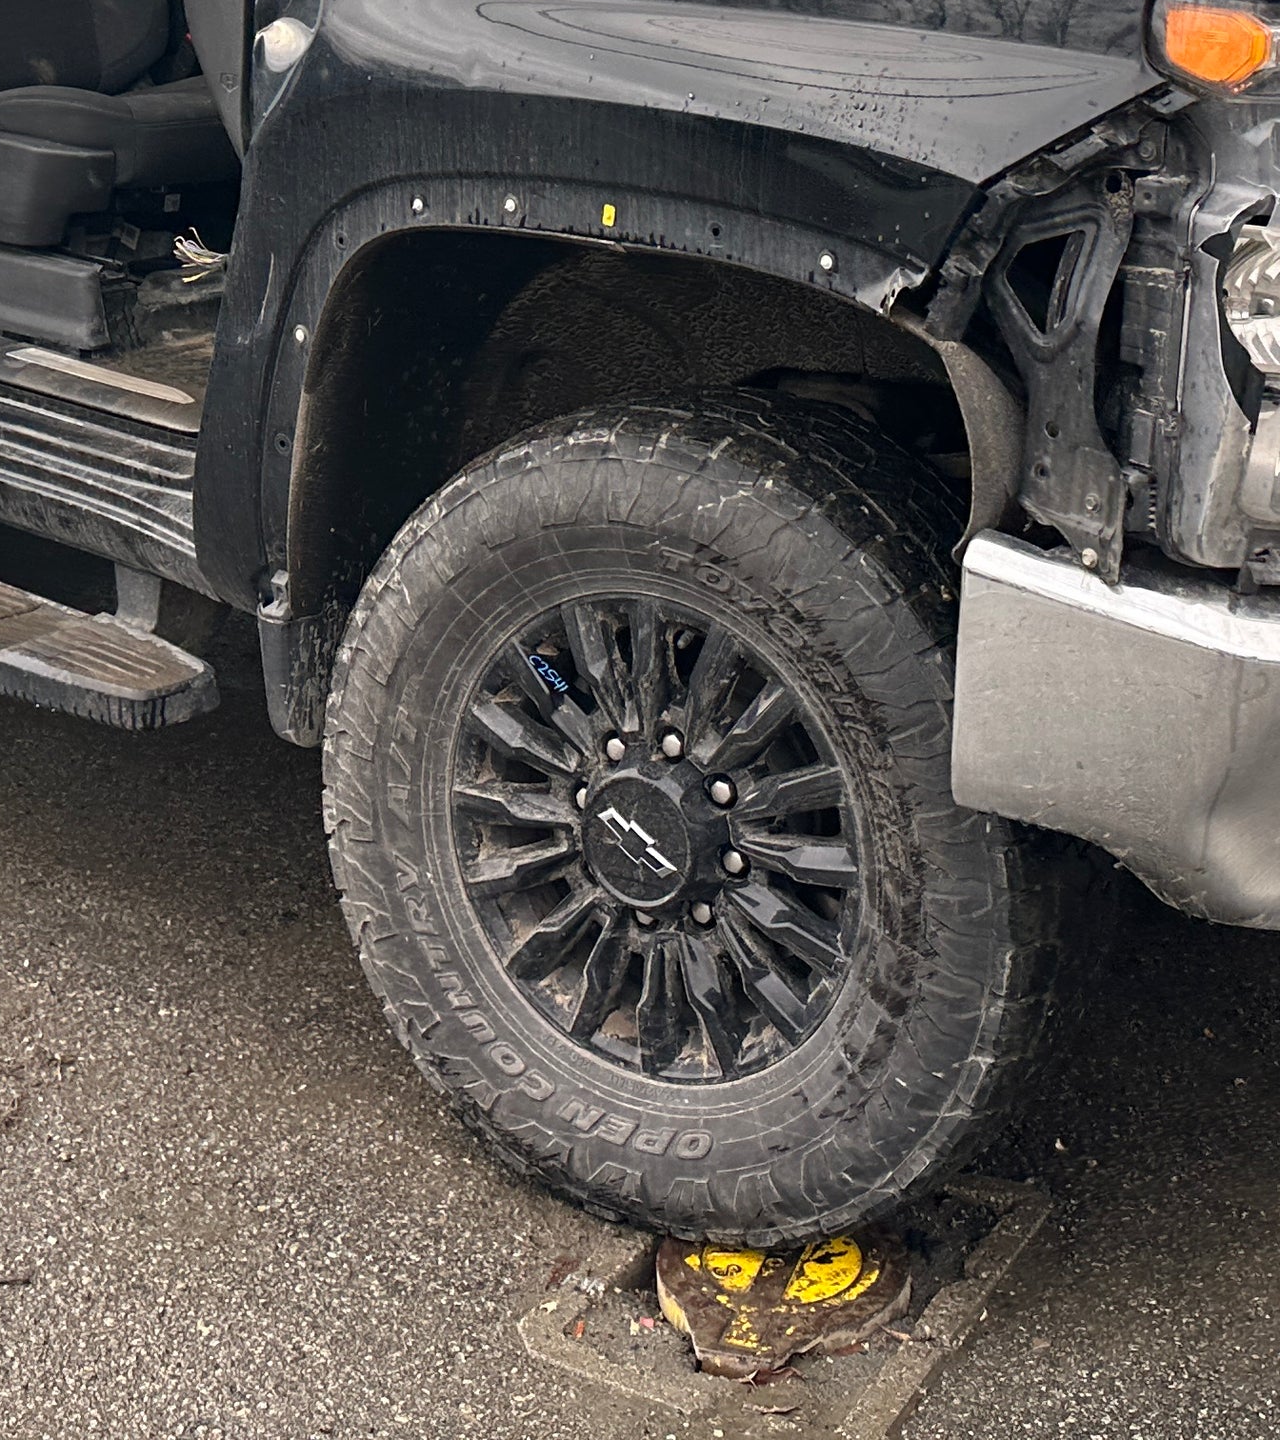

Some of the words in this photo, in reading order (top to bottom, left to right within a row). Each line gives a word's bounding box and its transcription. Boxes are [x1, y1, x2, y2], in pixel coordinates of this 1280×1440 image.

[528, 654, 569, 693] C2541
[393, 850, 556, 1103] COUNTRY
[555, 1097, 714, 1161] OPEN
